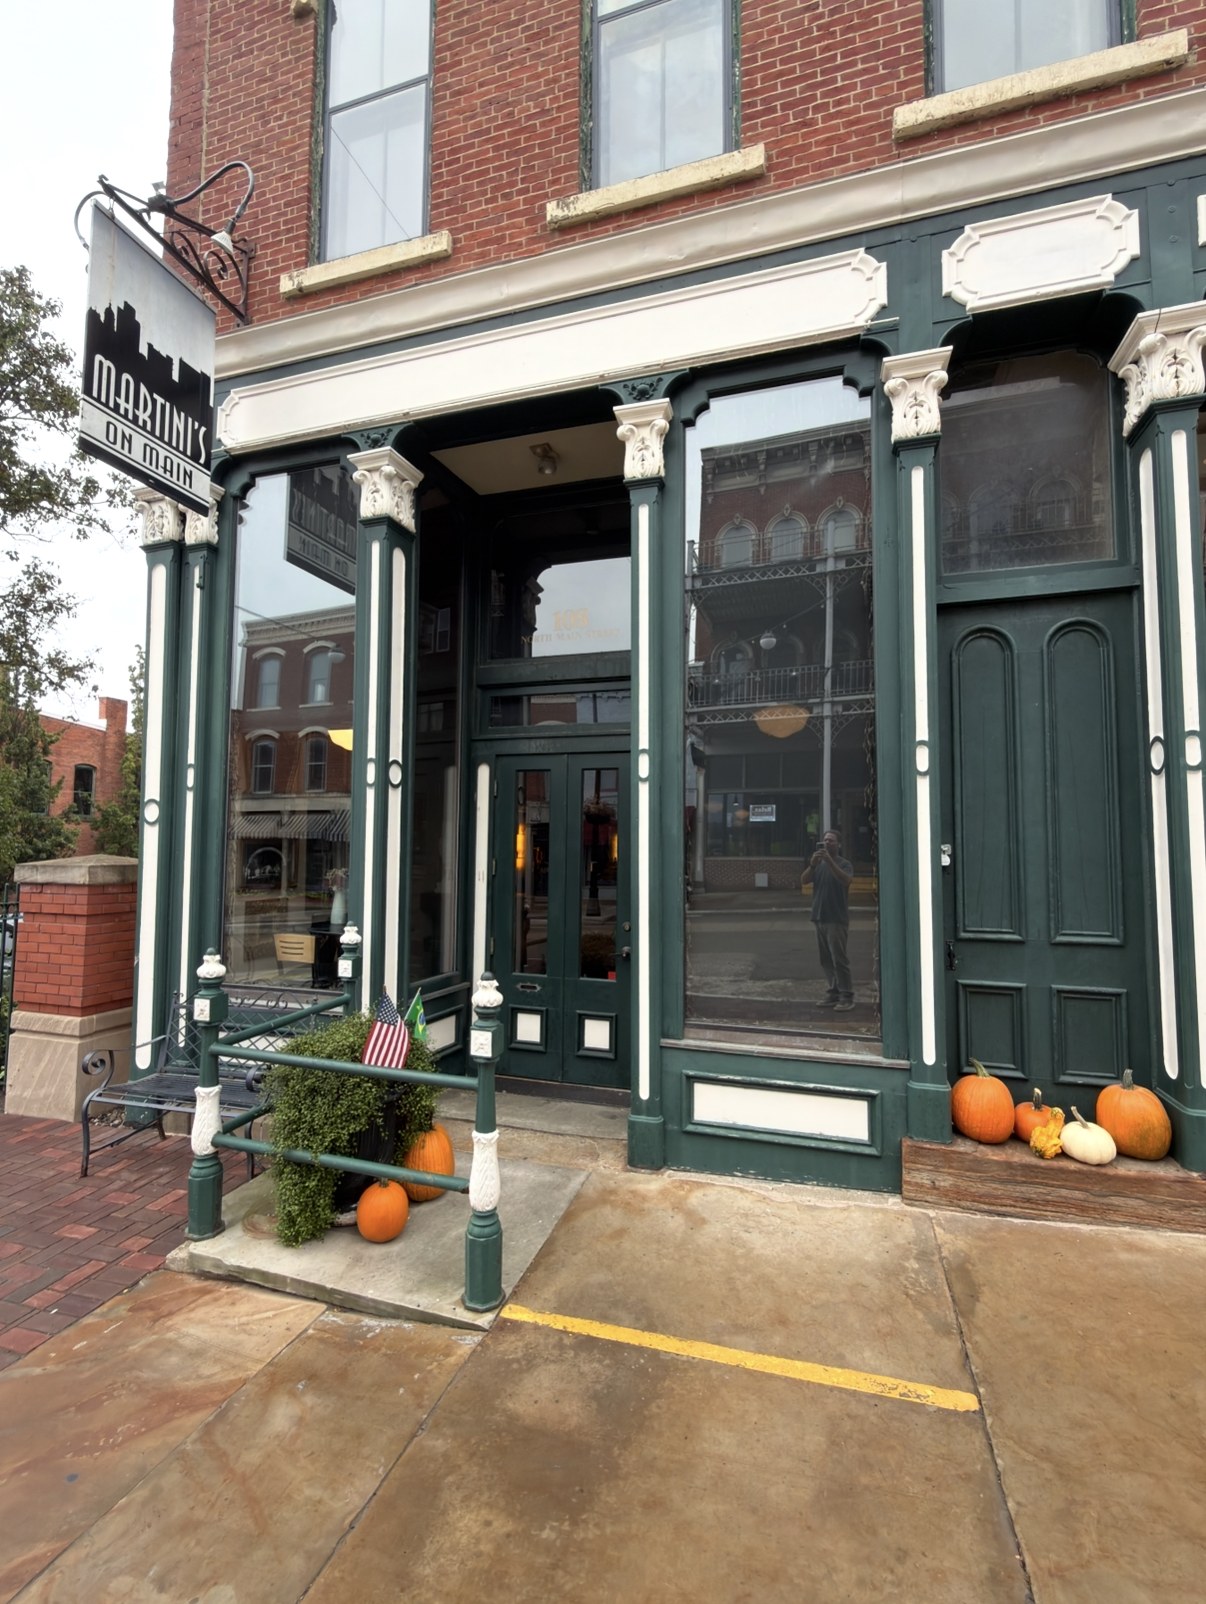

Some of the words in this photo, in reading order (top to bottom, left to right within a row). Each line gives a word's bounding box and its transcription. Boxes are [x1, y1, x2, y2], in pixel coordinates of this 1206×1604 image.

[92, 353, 207, 465] MARTINI'S
[105, 420, 133, 455] ON
[143, 442, 193, 490] MAIN
